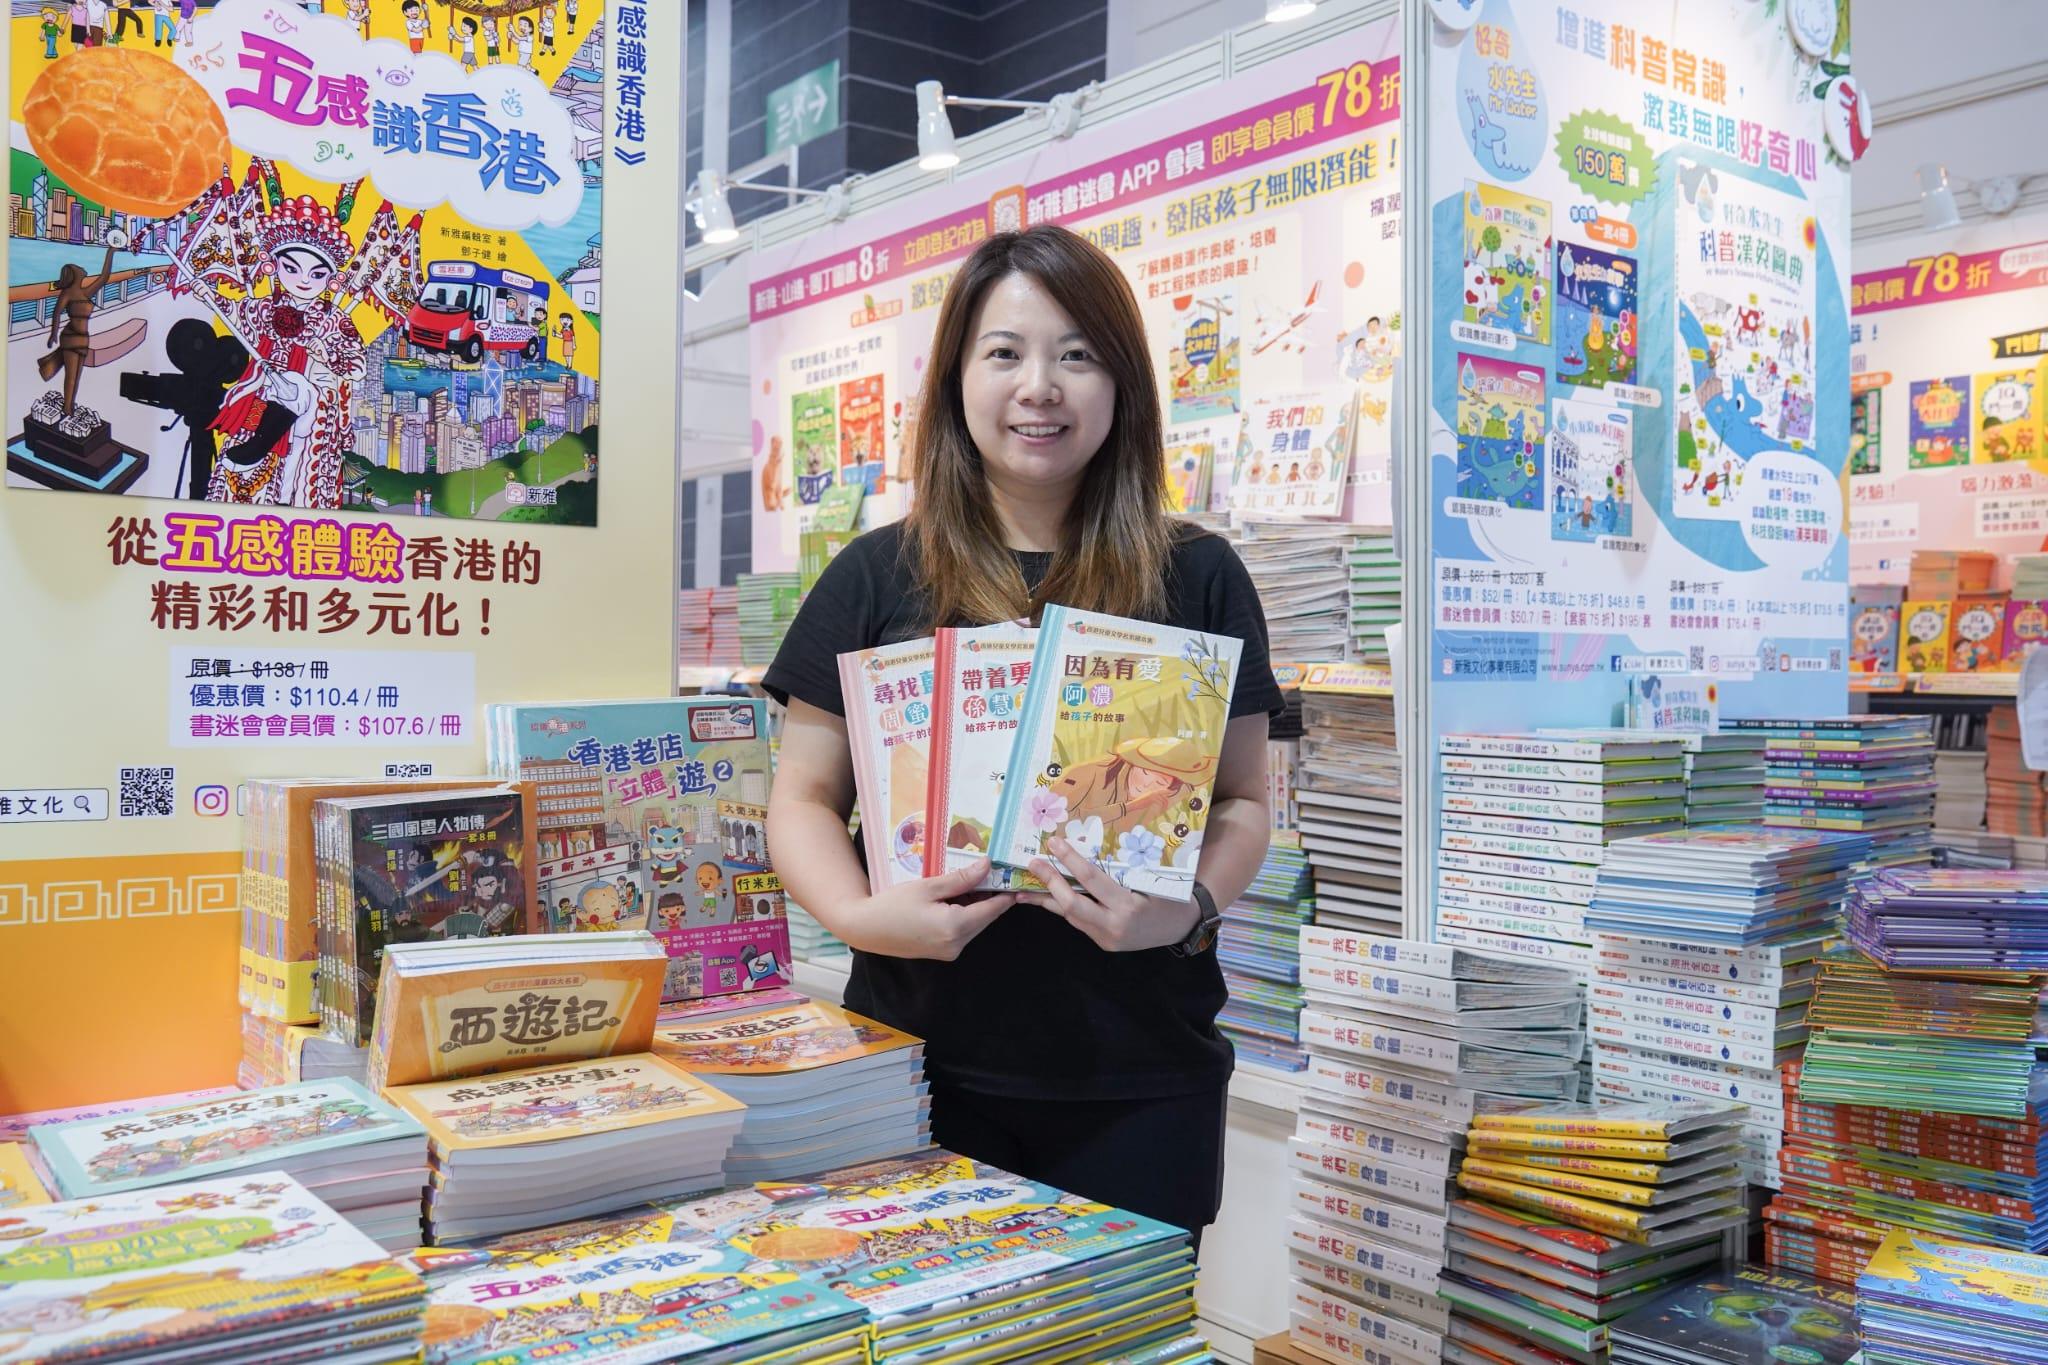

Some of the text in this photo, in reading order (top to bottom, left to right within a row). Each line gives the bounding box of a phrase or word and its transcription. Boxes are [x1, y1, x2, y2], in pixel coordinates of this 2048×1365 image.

[615, 0, 647, 165] 感識香港》
[1488, 62, 1537, 99] 水先生
[225, 30, 561, 196] 五感識香港
[1644, 91, 1818, 182] 激發無限好奇心
[1120, 158, 1160, 195] APP
[1700, 229, 1803, 285] 科普漢英圖典
[1266, 405, 1324, 430] 我們的
[528, 487, 557, 504] 新雅
[106, 512, 542, 586] 從五感體驗香港的
[150, 580, 492, 637] 精彩和多元化！
[1064, 654, 1163, 683] 因為有愛
[1065, 684, 1112, 706] 阿濃
[1060, 710, 1125, 723] 給孩子的故事
[568, 733, 684, 774] 香港老店
[371, 814, 485, 841] 三國風雲人物傳
[1333, 938, 1397, 962] 我們的身體
[1334, 969, 1399, 994] 我們的身體
[449, 994, 618, 1046] 西遊記
[1334, 1027, 1401, 1054] 我們的身體
[447, 1068, 620, 1103] 成語故事
[1344, 1070, 1414, 1100] 我們的身體
[101, 1094, 302, 1142] 成語故事
[1330, 1123, 1394, 1154] 我們的身體
[1322, 1154, 1388, 1186] 我們的身體
[1324, 1196, 1390, 1228] 我們的身體
[1318, 1235, 1384, 1270] 我們的身體
[1323, 1264, 1391, 1299] 我們的身體
[1322, 1300, 1386, 1339] 我們的身體
